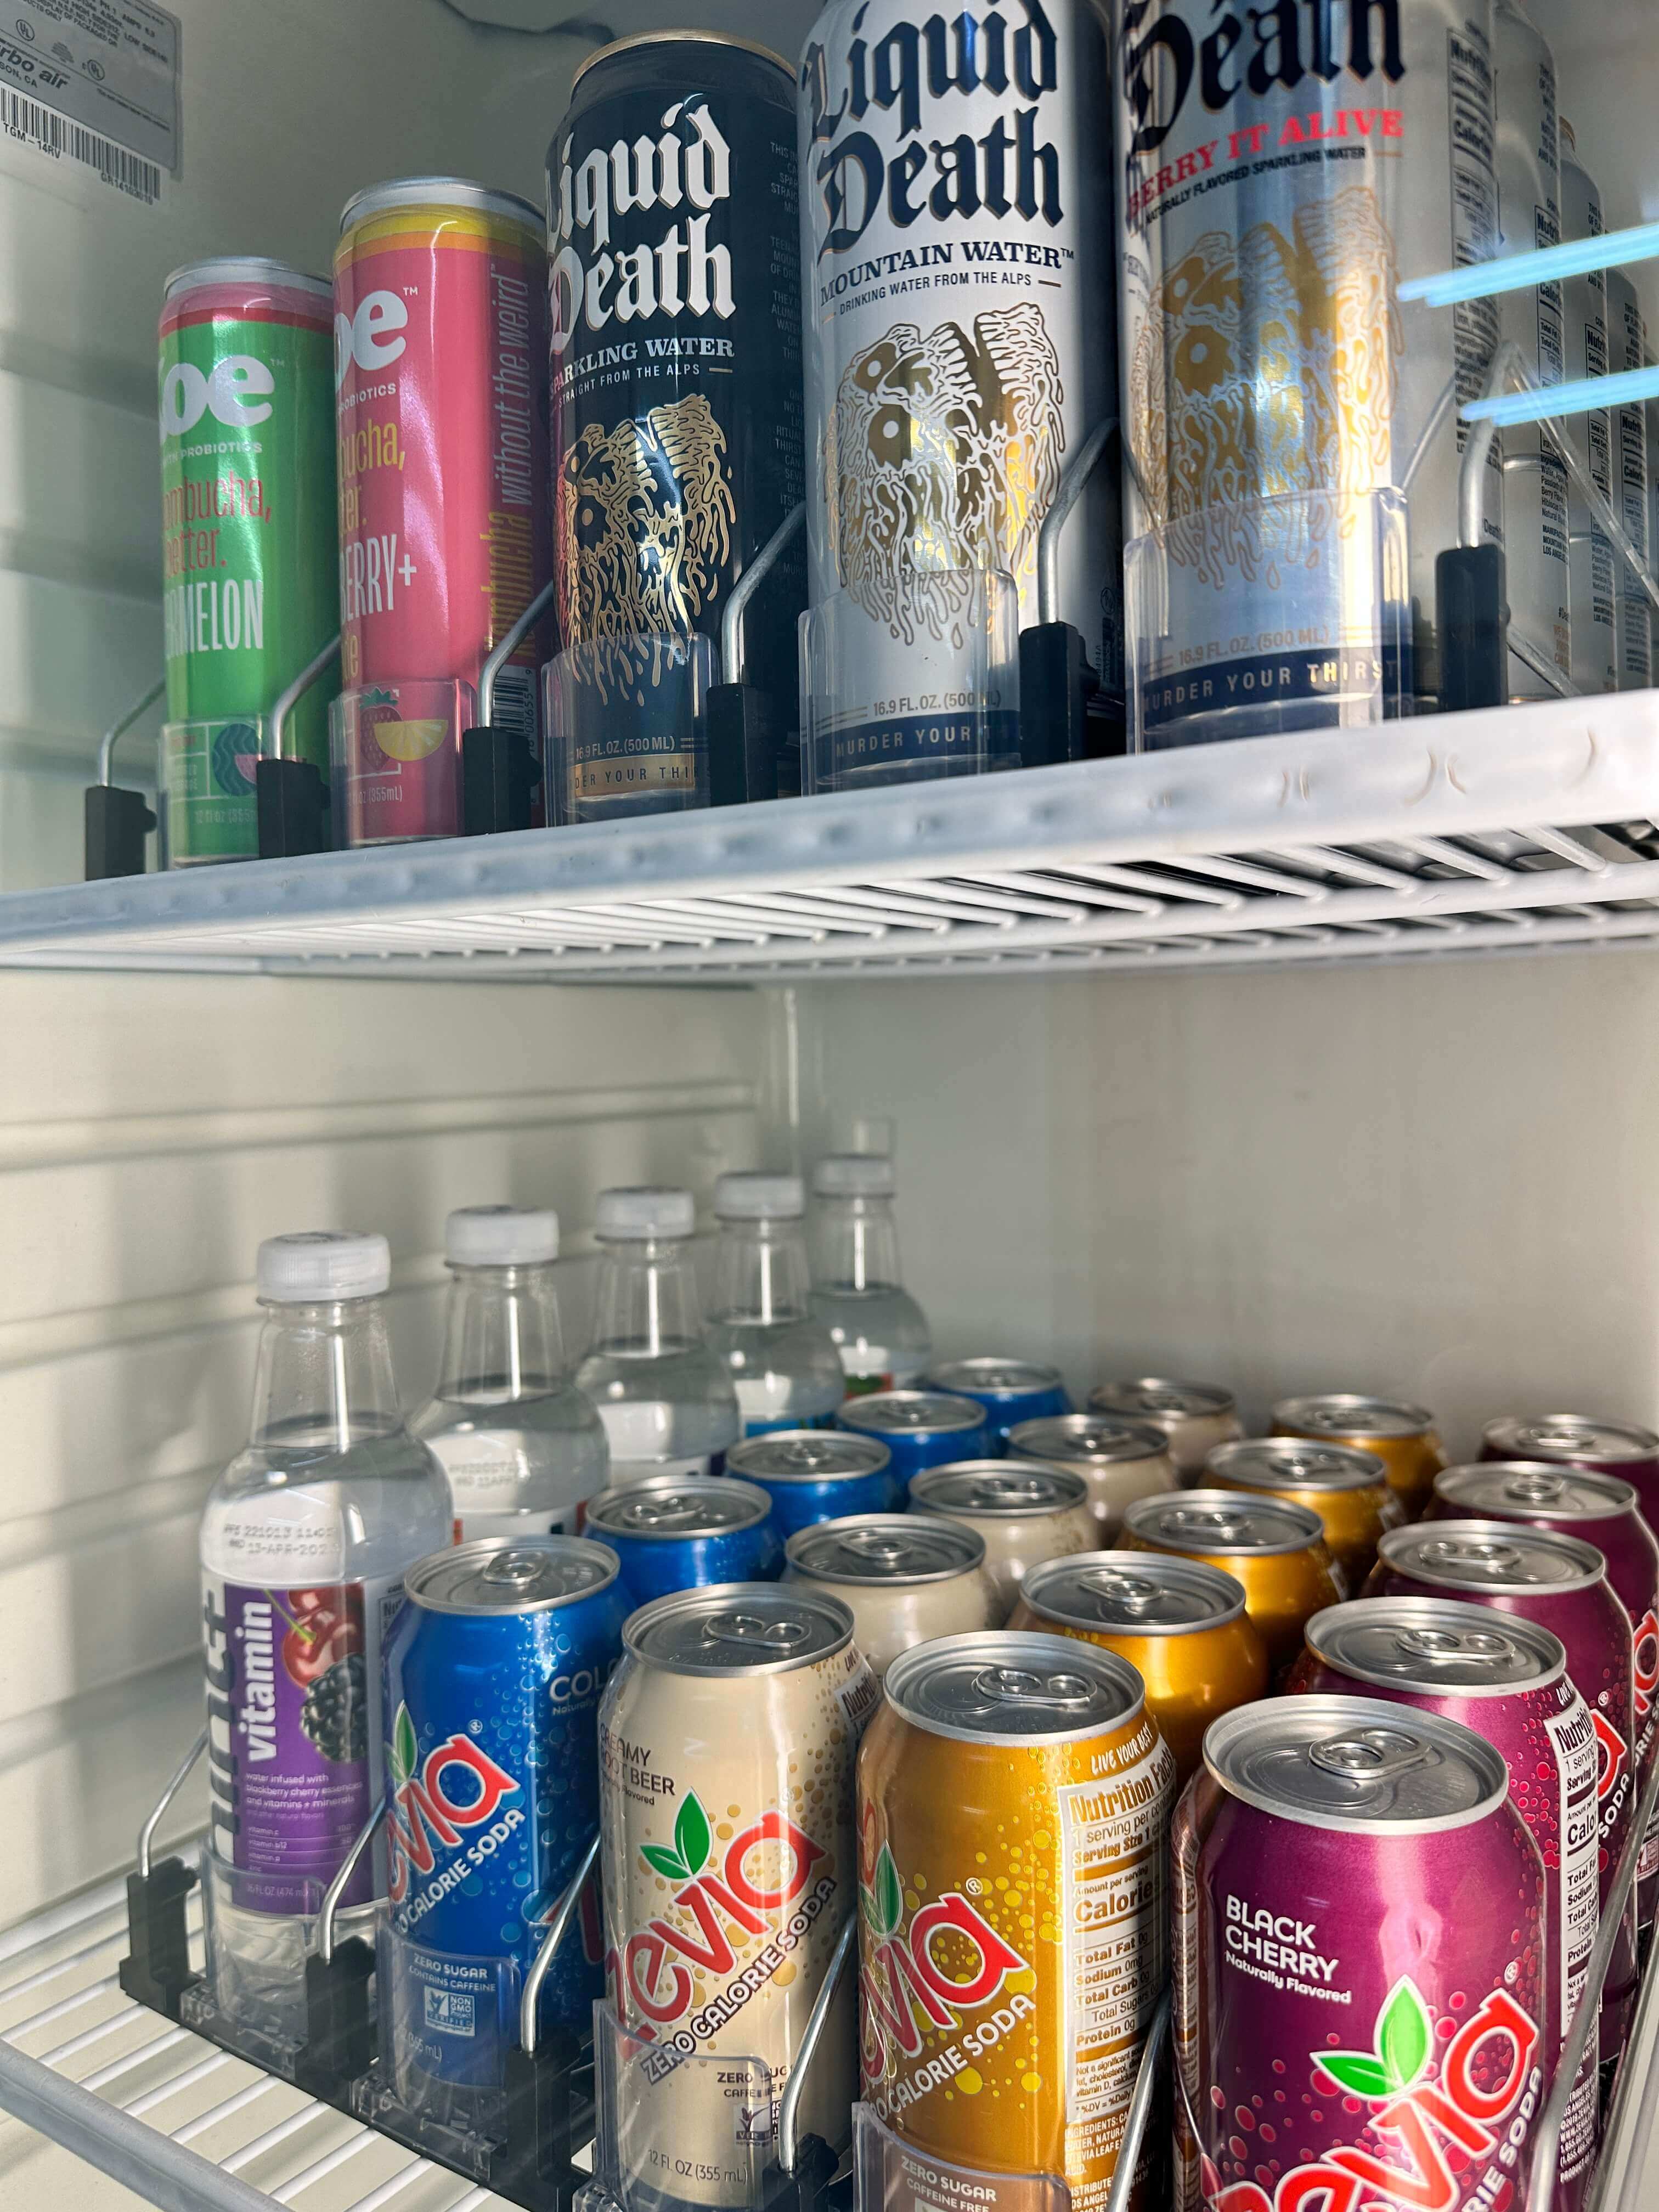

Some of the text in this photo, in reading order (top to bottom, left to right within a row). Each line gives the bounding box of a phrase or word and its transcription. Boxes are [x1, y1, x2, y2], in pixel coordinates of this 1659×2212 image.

[40, 70, 68, 89] air
[802, 0, 1057, 144] Liquid
[1128, 108, 1404, 219] BERRY IT ALIVE
[1194, 167, 1250, 197] FLAVORED
[1250, 151, 1322, 175] SPARKLING
[1324, 146, 1365, 161] WATER
[816, 106, 1064, 264] Death
[549, 213, 737, 354] Death
[820, 242, 953, 304] MOUNTAIN
[839, 272, 1031, 315] DRINKING WATER FROM THE ALPS
[490, 273, 530, 351] weird
[645, 337, 735, 358] WATER
[492, 353, 531, 400] the
[600, 368, 630, 387] FROM
[636, 365, 660, 378] THE
[667, 363, 700, 376] ALPS
[492, 402, 533, 506] without
[1227, 666, 1291, 692] YOUR
[835, 725, 970, 757] MURDER YOUR
[605, 768, 647, 783] YOUR
[235, 1601, 276, 1762] vitamin
[1091, 1722, 1154, 1775] LIVE YOUR BEST
[245, 1773, 329, 1783] water infused with
[290, 1787, 321, 1798] cherry
[630, 1766, 675, 1796] BEER
[1068, 1747, 1176, 1826] Nutrition Facts
[246, 1795, 355, 1809] and vitamins minerals
[1598, 1772, 1630, 1839] SODA
[1086, 1809, 1149, 1844] serving per
[1072, 1833, 1143, 1865] Serving Size
[407, 1808, 526, 1927] CALORIE SODA
[1073, 1864, 1149, 1898] Amount per serving
[1567, 1868, 1589, 1886] Total
[1226, 1894, 1317, 1950] BLACK
[1567, 1908, 1587, 1925] Total
[414, 1953, 488, 1979] ZERO SUGAR
[1075, 1937, 1136, 1966] Total Fat
[1225, 1924, 1339, 1982] CHERRY
[408, 1965, 496, 1992] CONTAINS CAFFEINE
[640, 1876, 838, 2084] ZERO CALORIE SODA
[1074, 1955, 1143, 1986] Sodium 0mg
[1225, 1950, 1352, 2006] Naturally Flavored
[450, 1996, 471, 2006] NON
[1075, 1976, 1138, 2006] Total Carb
[1092, 1989, 1149, 2023] Total Sugars
[450, 2003, 472, 2013] GMO
[1075, 2018, 1135, 2046] Protein 0g
[888, 2044, 968, 2114] CALORIE
[962, 1994, 1036, 2057] SODA
[1076, 2066, 1089, 2075] Not
[716, 2071, 753, 2084] ZERO
[1075, 2084, 1102, 2097] vitamin
[1498, 2065, 1543, 2168] SODA
[1095, 2143, 1114, 2157] LEAF
[647, 2149, 748, 2185] 12 OZ (355 mL)
[901, 2155, 997, 2202] ZERO SUGAR
[906, 2177, 957, 2208] CAFFEINE
